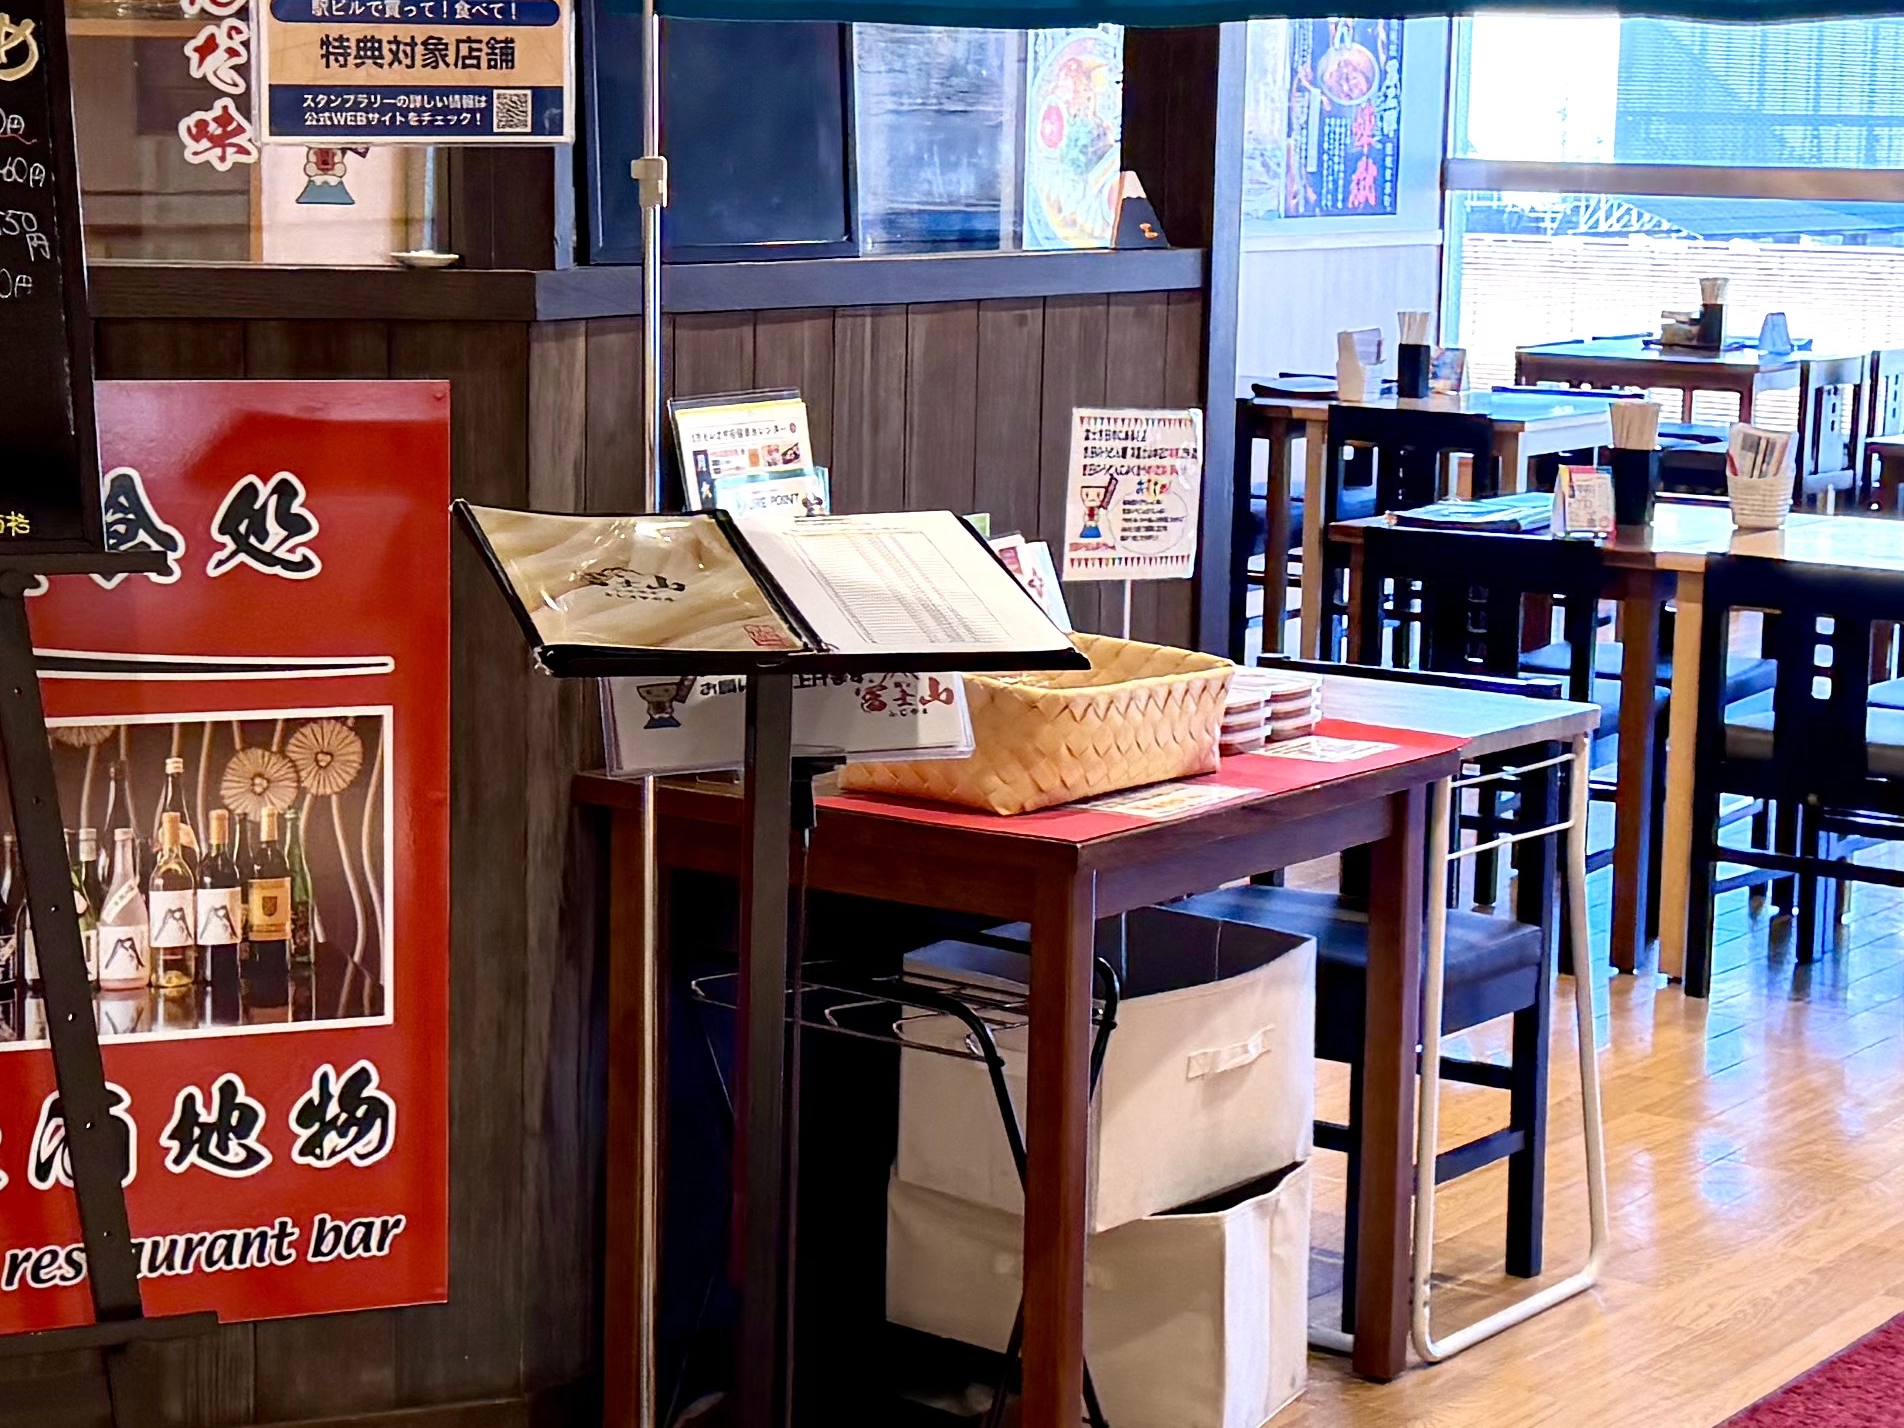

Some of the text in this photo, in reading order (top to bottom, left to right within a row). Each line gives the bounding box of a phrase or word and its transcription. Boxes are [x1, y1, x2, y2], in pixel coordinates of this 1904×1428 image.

[319, 33, 516, 71] 特典対象店舗
[302, 93, 487, 109] スタンプラリーの詳しい情報は
[304, 112, 481, 127] 公式WEBサイトをチェック!
[307, 1212, 406, 1265] bar
